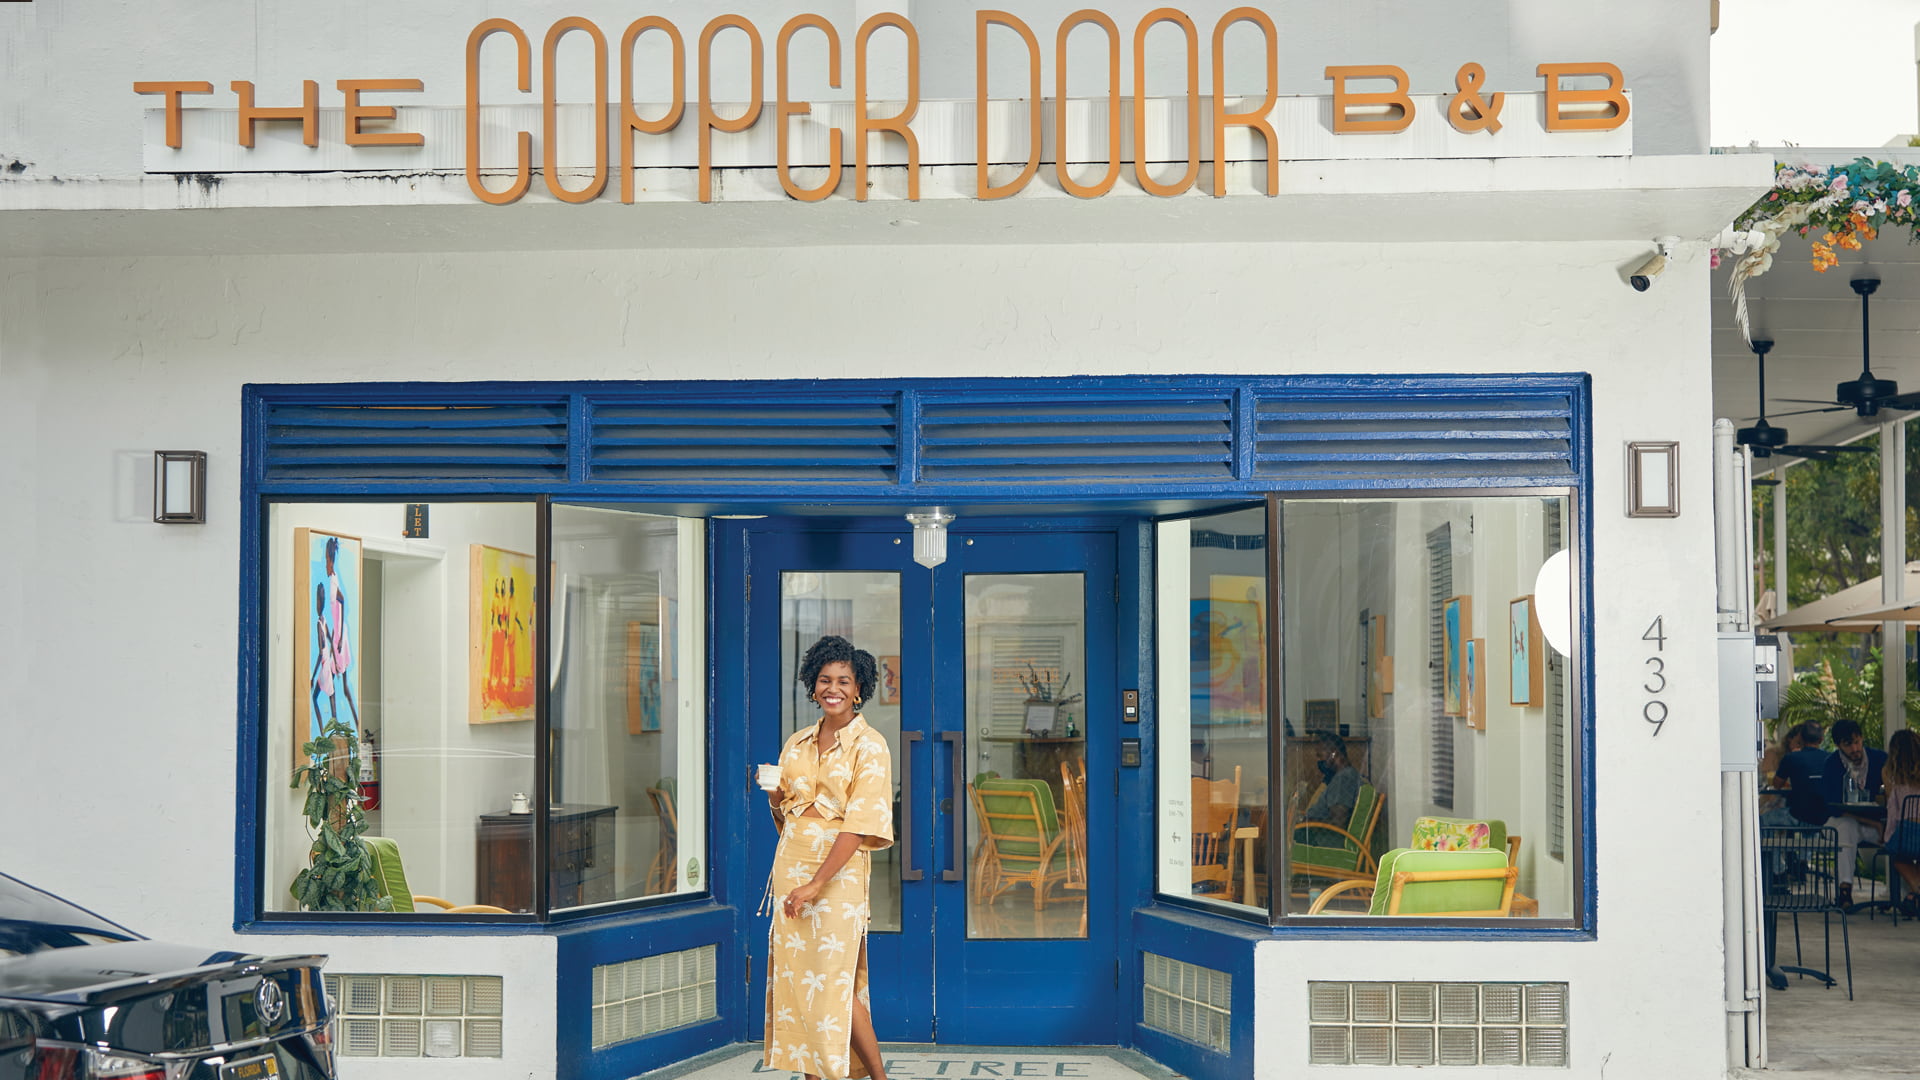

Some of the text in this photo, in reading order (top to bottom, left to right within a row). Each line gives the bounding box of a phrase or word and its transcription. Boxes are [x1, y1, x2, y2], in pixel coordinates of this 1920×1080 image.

[134, 79, 424, 148] THE
[466, 12, 920, 205] COPPER
[976, 7, 1279, 198] DOOR
[1641, 614, 1669, 737] 439
